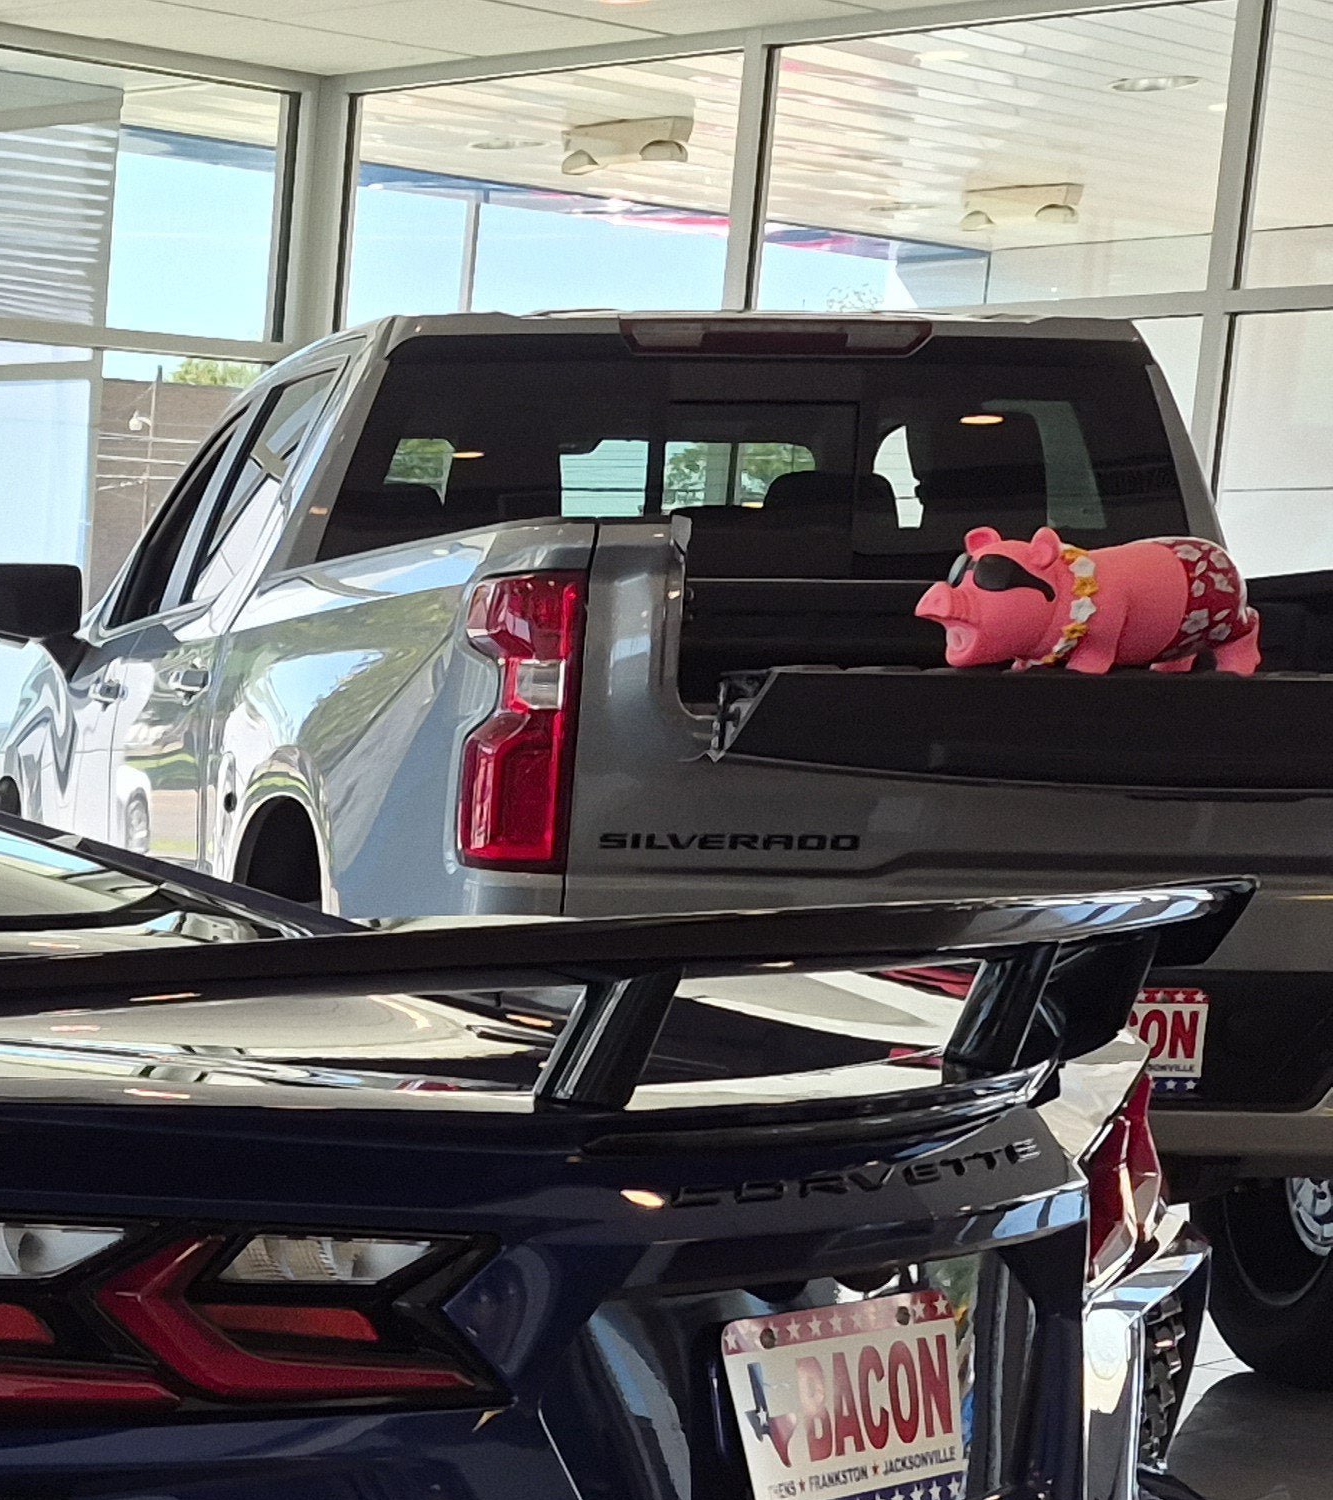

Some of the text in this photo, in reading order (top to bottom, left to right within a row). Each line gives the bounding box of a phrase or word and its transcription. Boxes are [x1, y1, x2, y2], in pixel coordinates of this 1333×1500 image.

[599, 832, 861, 851] SILVERADO
[670, 1138, 1041, 1208] CORVETTE
[796, 1333, 954, 1462] BACON
[808, 1465, 869, 1493] FRANKSTON
[883, 1446, 957, 1475] JACKSONVILLE
